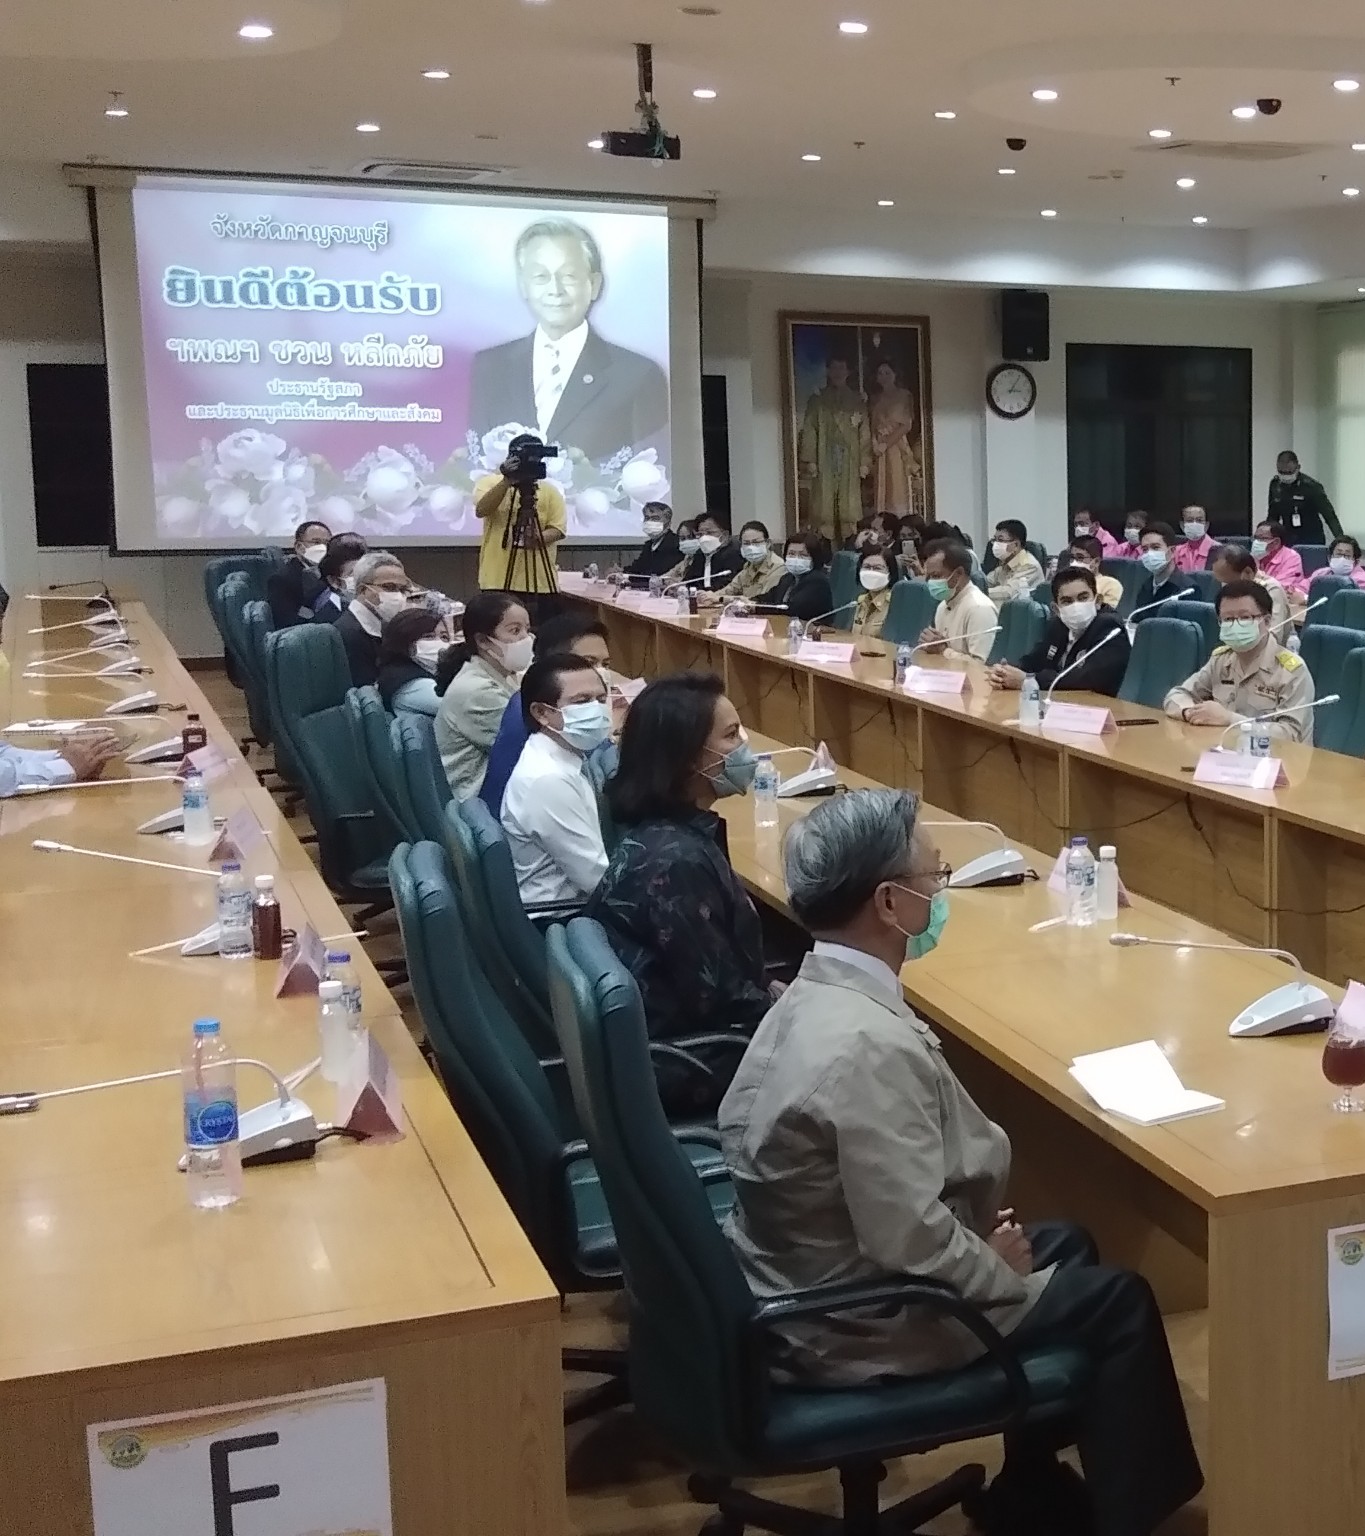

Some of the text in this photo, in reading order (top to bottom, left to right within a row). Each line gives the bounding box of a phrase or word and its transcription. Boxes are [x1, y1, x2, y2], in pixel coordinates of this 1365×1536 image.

[210, 213, 389, 251] จังหวัดกาญจนบุรี
[164, 265, 441, 314] ยินดีต้อนรับ
[269, 340, 332, 365] ชวน
[340, 333, 444, 368] หลีกภัย
[267, 377, 362, 400] ประธานรัฐสภา
